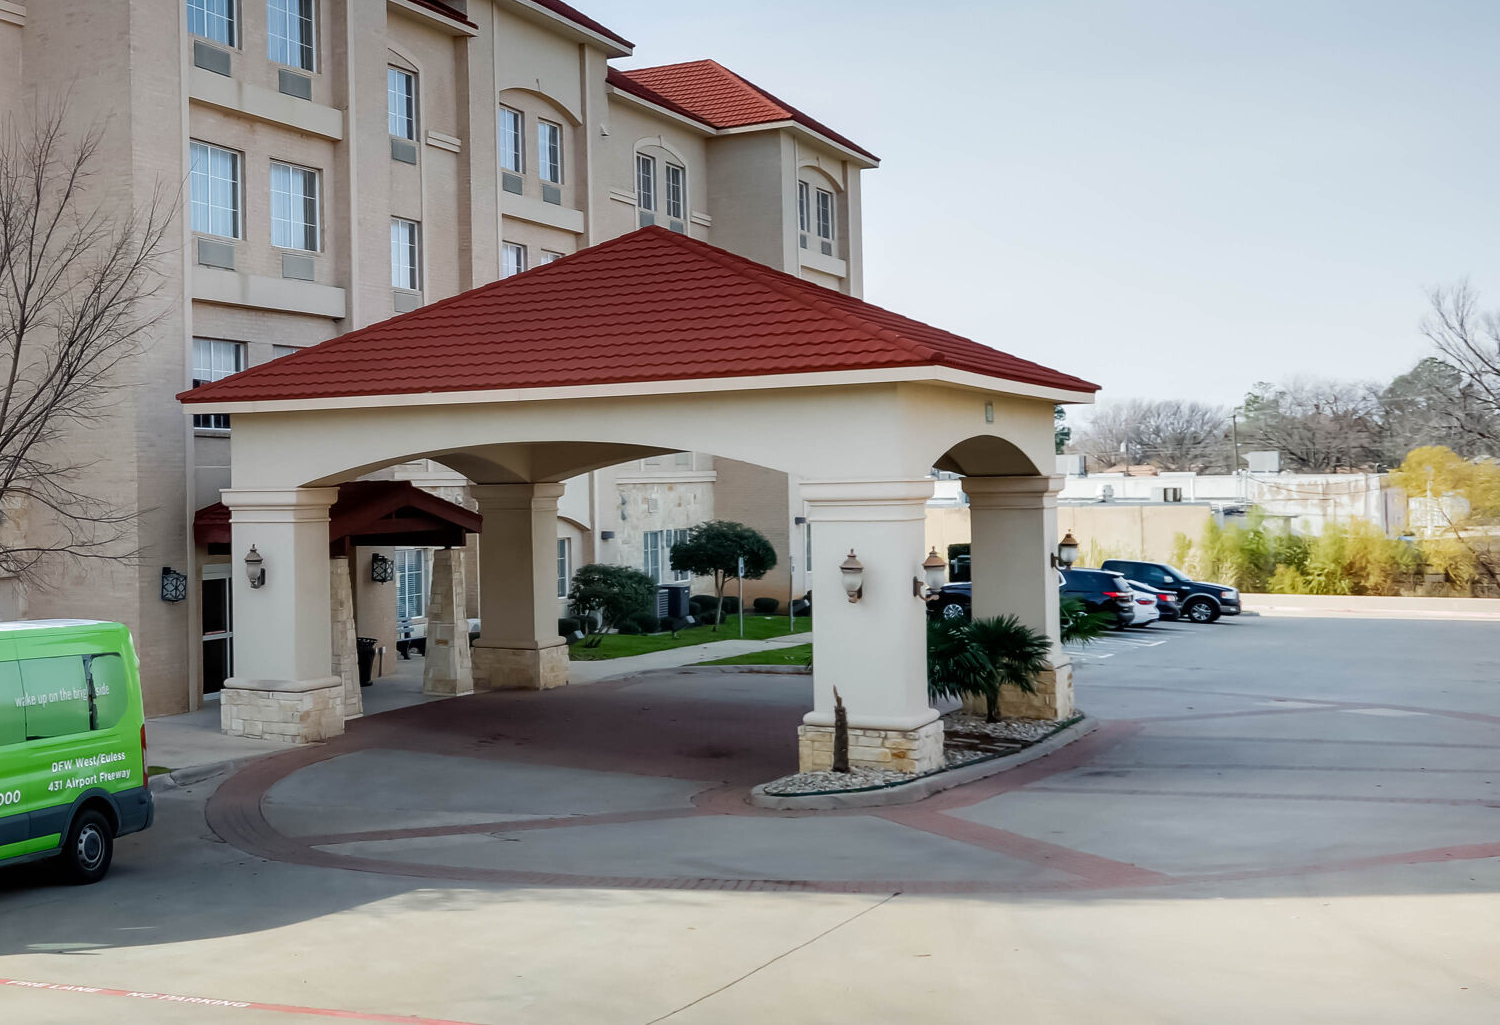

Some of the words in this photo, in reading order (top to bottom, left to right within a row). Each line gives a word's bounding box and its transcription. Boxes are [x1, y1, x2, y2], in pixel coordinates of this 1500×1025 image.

[14, 692, 37, 708] wake
[37, 694, 48, 708] up
[48, 692, 58, 703] on
[59, 688, 73, 701] the
[51, 758, 73, 773] DFW
[75, 751, 126, 768] West/Euless
[48, 779, 63, 792] 431
[65, 774, 98, 789] Airport
[99, 768, 131, 783] Freeway
[5, 980, 50, 989] FIRE
[49, 984, 102, 993] LANE
[125, 991, 159, 999] NO
[158, 993, 252, 1008] PARKING
